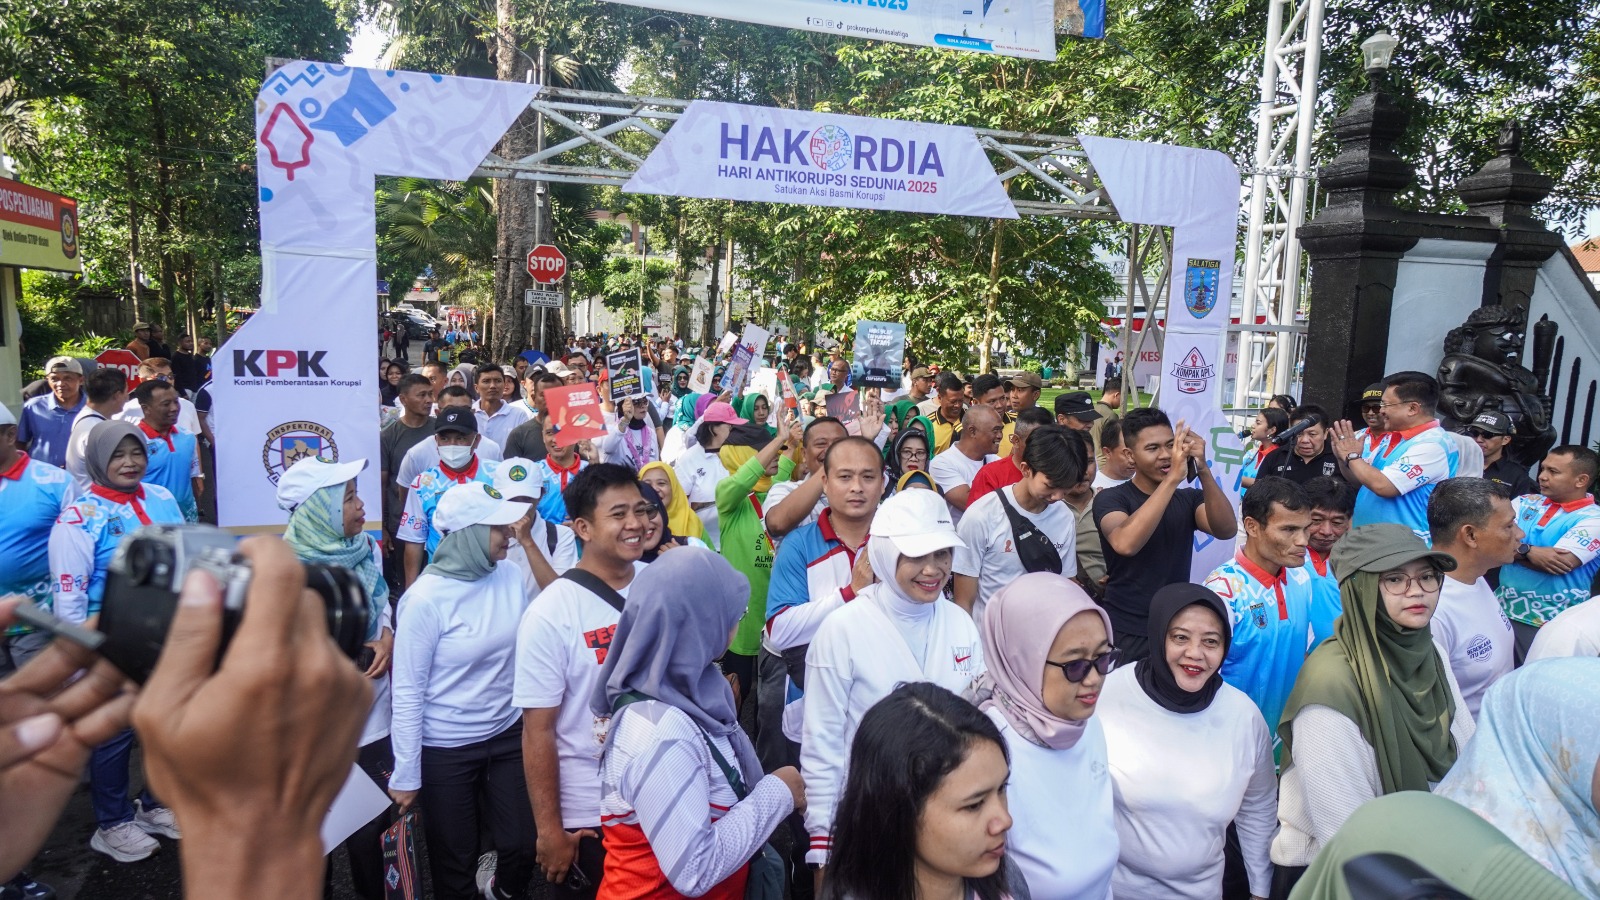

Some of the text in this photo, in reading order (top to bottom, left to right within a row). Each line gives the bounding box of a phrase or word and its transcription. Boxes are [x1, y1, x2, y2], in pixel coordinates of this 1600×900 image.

[717, 164, 938, 194] HARI ANTIKORUPSI SEDUNIA 2025
[774, 183, 886, 202] Satukan Aksi Basmi Korupsi
[530, 255, 564, 272] STOP
[1188, 259, 1219, 269] SALATIGA
[97, 362, 140, 381] OP
[232, 349, 330, 378] KPK
[1175, 366, 1210, 379] KOMPAK API
[234, 378, 362, 388] Komisi Pemberantasan Korupsi
[271, 423, 330, 438] INSPEKTORAT
